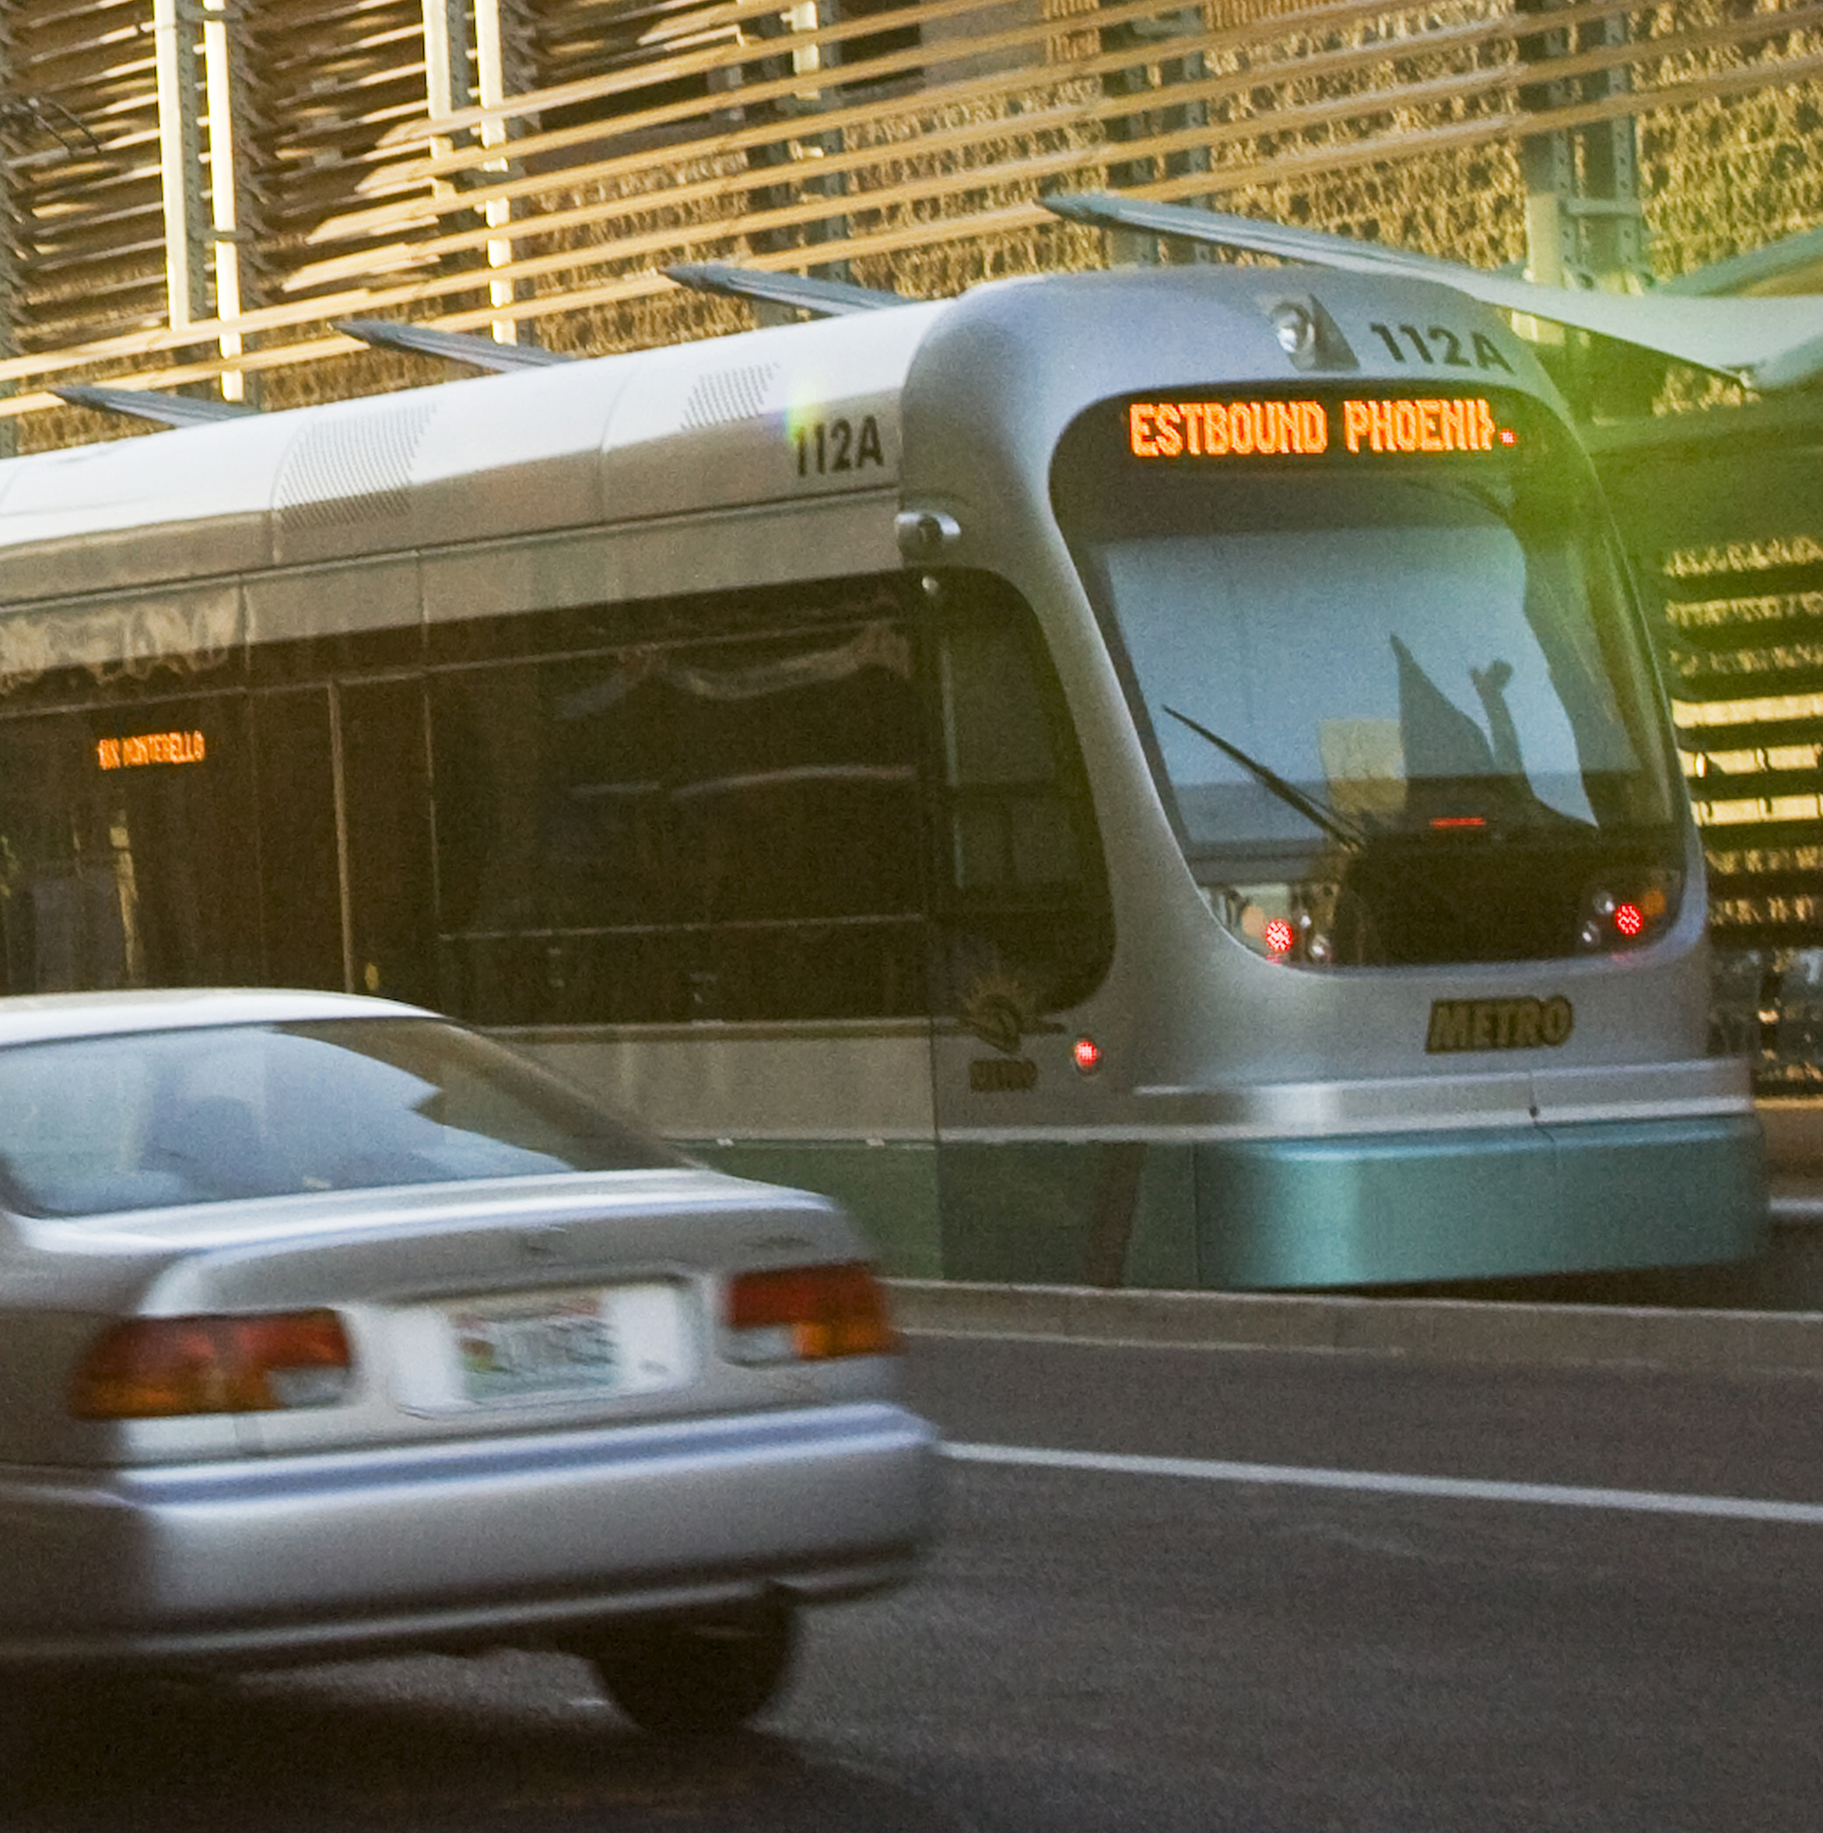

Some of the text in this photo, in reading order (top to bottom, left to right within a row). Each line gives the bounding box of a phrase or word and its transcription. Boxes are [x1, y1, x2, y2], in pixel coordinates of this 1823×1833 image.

[1370, 322, 1516, 376] 112A
[795, 415, 884, 477] 112A
[1129, 401, 1328, 457] ESTBOUND
[1426, 995, 1575, 1055] METRO
